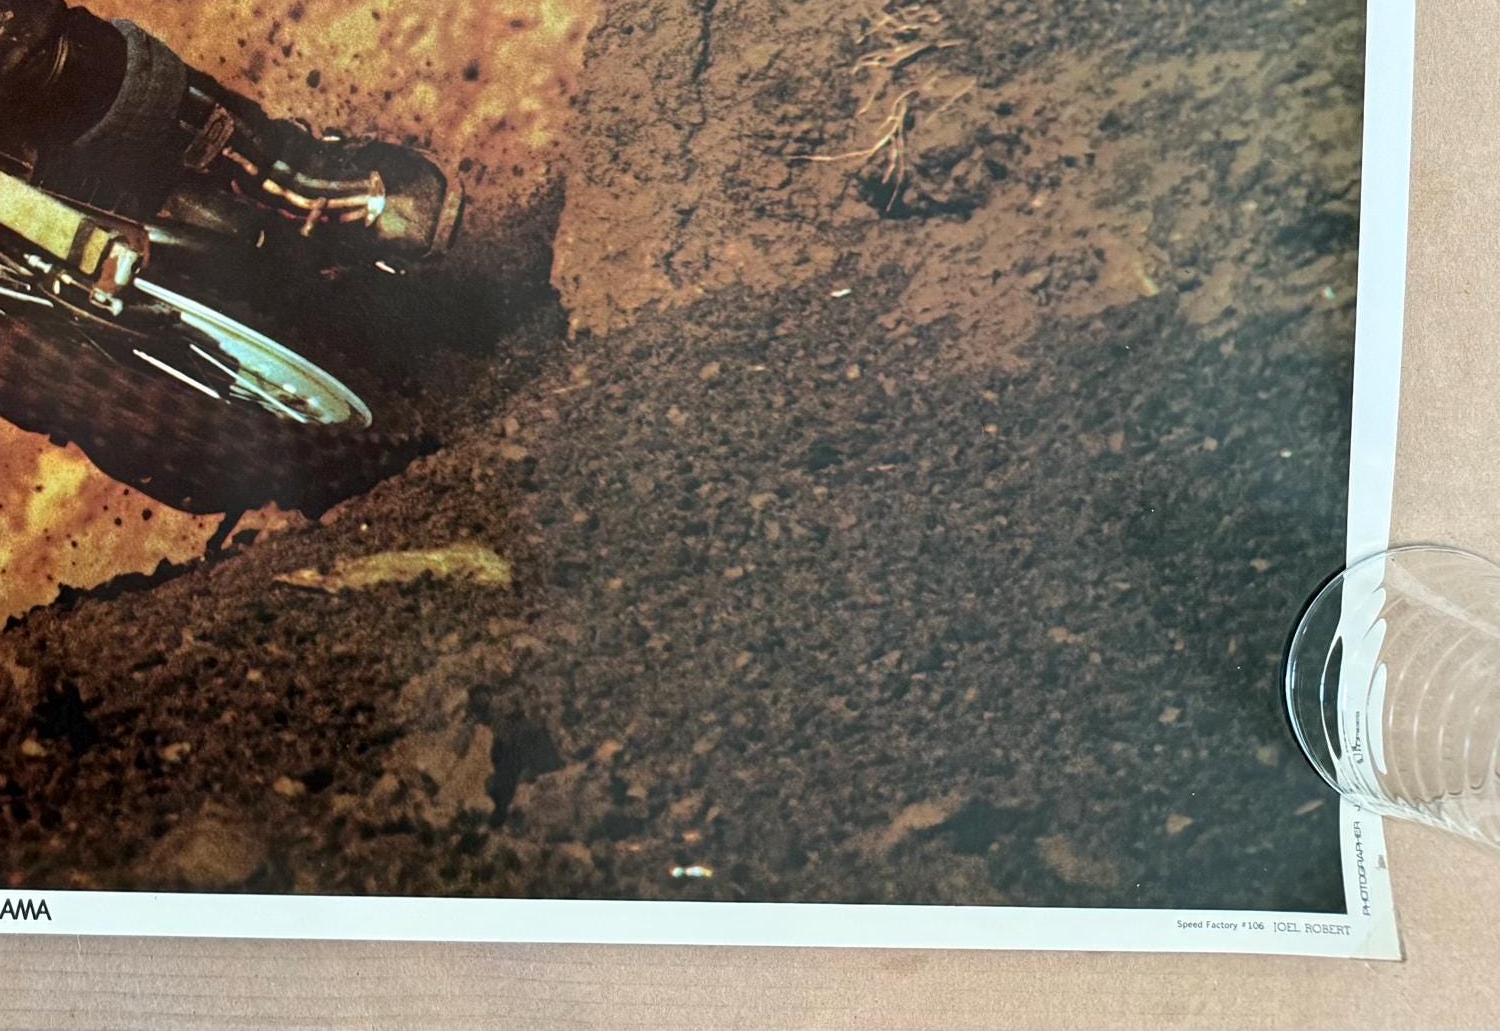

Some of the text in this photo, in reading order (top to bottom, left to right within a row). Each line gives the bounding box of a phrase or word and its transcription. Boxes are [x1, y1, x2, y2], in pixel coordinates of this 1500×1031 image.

[1353, 820, 1371, 916] PHOTOGRAPHER
[1177, 920, 1265, 931] Speed Factory #106
[1273, 921, 1351, 936] JOEL ROBERT
